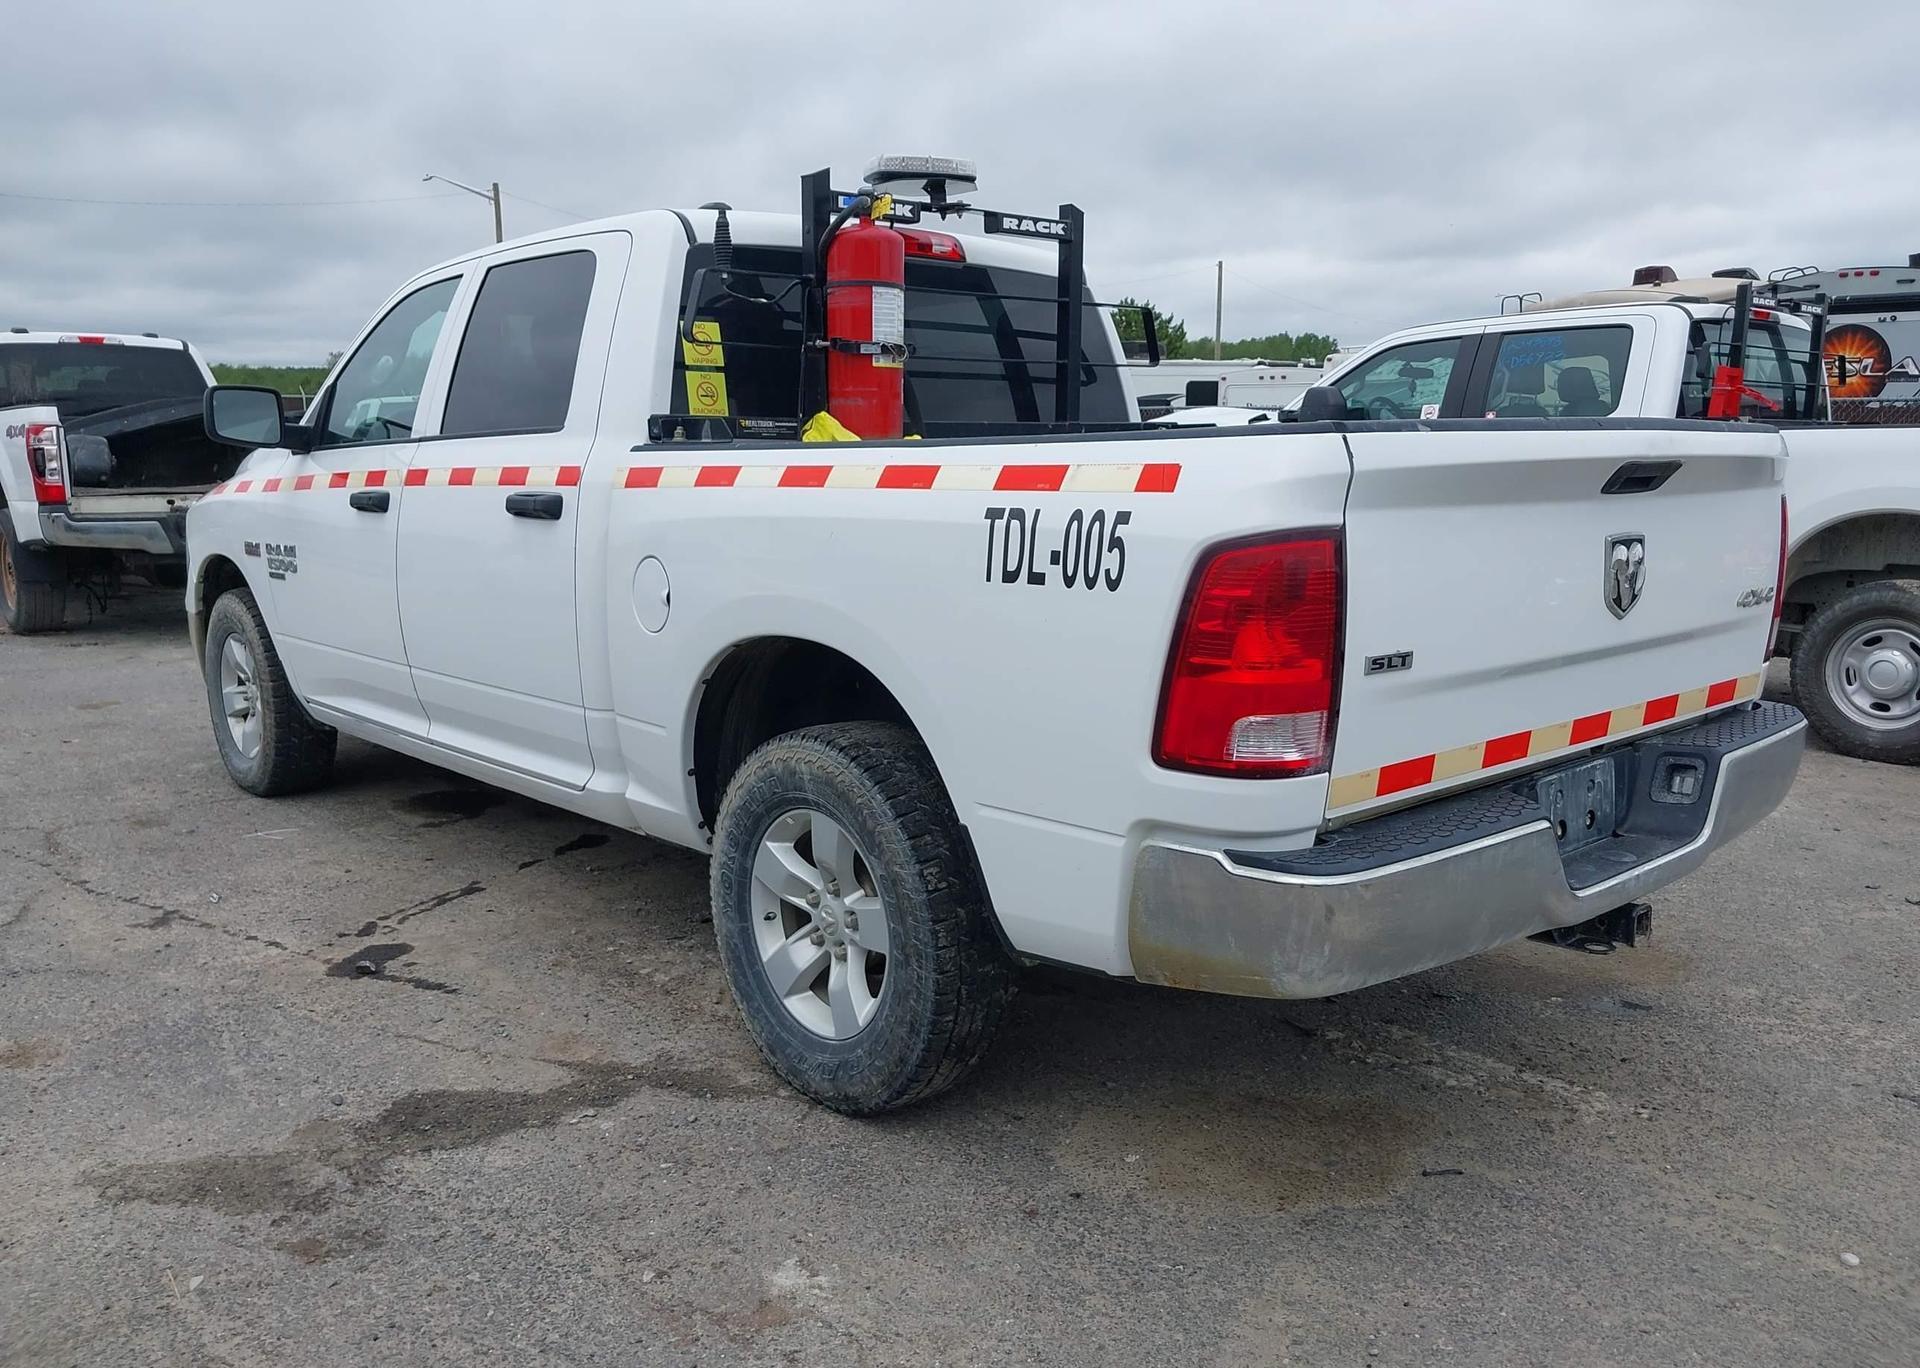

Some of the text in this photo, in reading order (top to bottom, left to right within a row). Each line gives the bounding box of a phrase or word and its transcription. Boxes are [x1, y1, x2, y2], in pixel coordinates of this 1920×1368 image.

[1002, 216, 1068, 236] RACK
[1801, 304, 1822, 314] RACK
[694, 322, 706, 330] NO
[691, 357, 719, 365] VAPING
[699, 373, 712, 381] NO
[692, 407, 726, 416] SMOKING
[265, 543, 297, 559] RAM
[984, 507, 1133, 592] TDL-005
[1370, 653, 1412, 671] SLT
